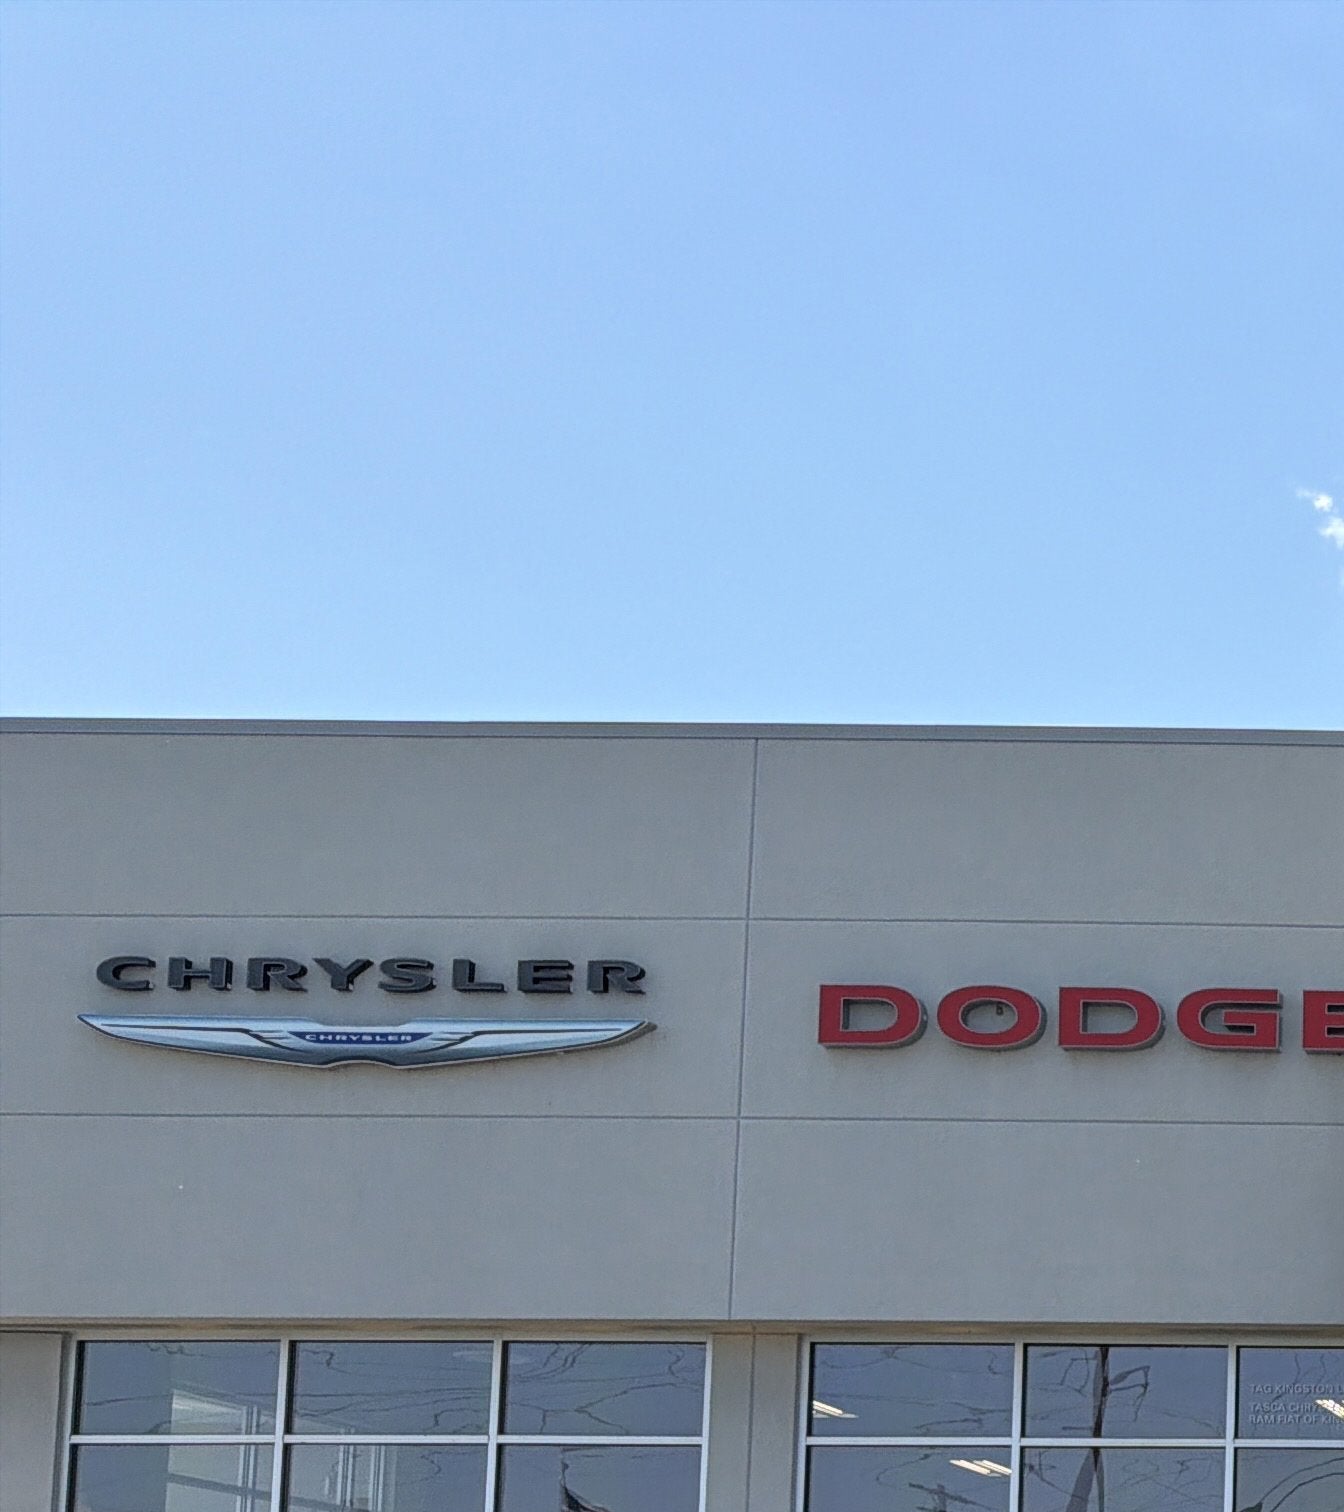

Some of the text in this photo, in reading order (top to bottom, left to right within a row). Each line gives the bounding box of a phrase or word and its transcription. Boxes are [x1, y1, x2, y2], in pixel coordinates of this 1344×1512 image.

[96, 957, 646, 995] CHRYSLER
[305, 1034, 412, 1042] CHRYSLER
[1275, 1384, 1333, 1394] KINGSTON
[1304, 1414, 1319, 1424] OF
